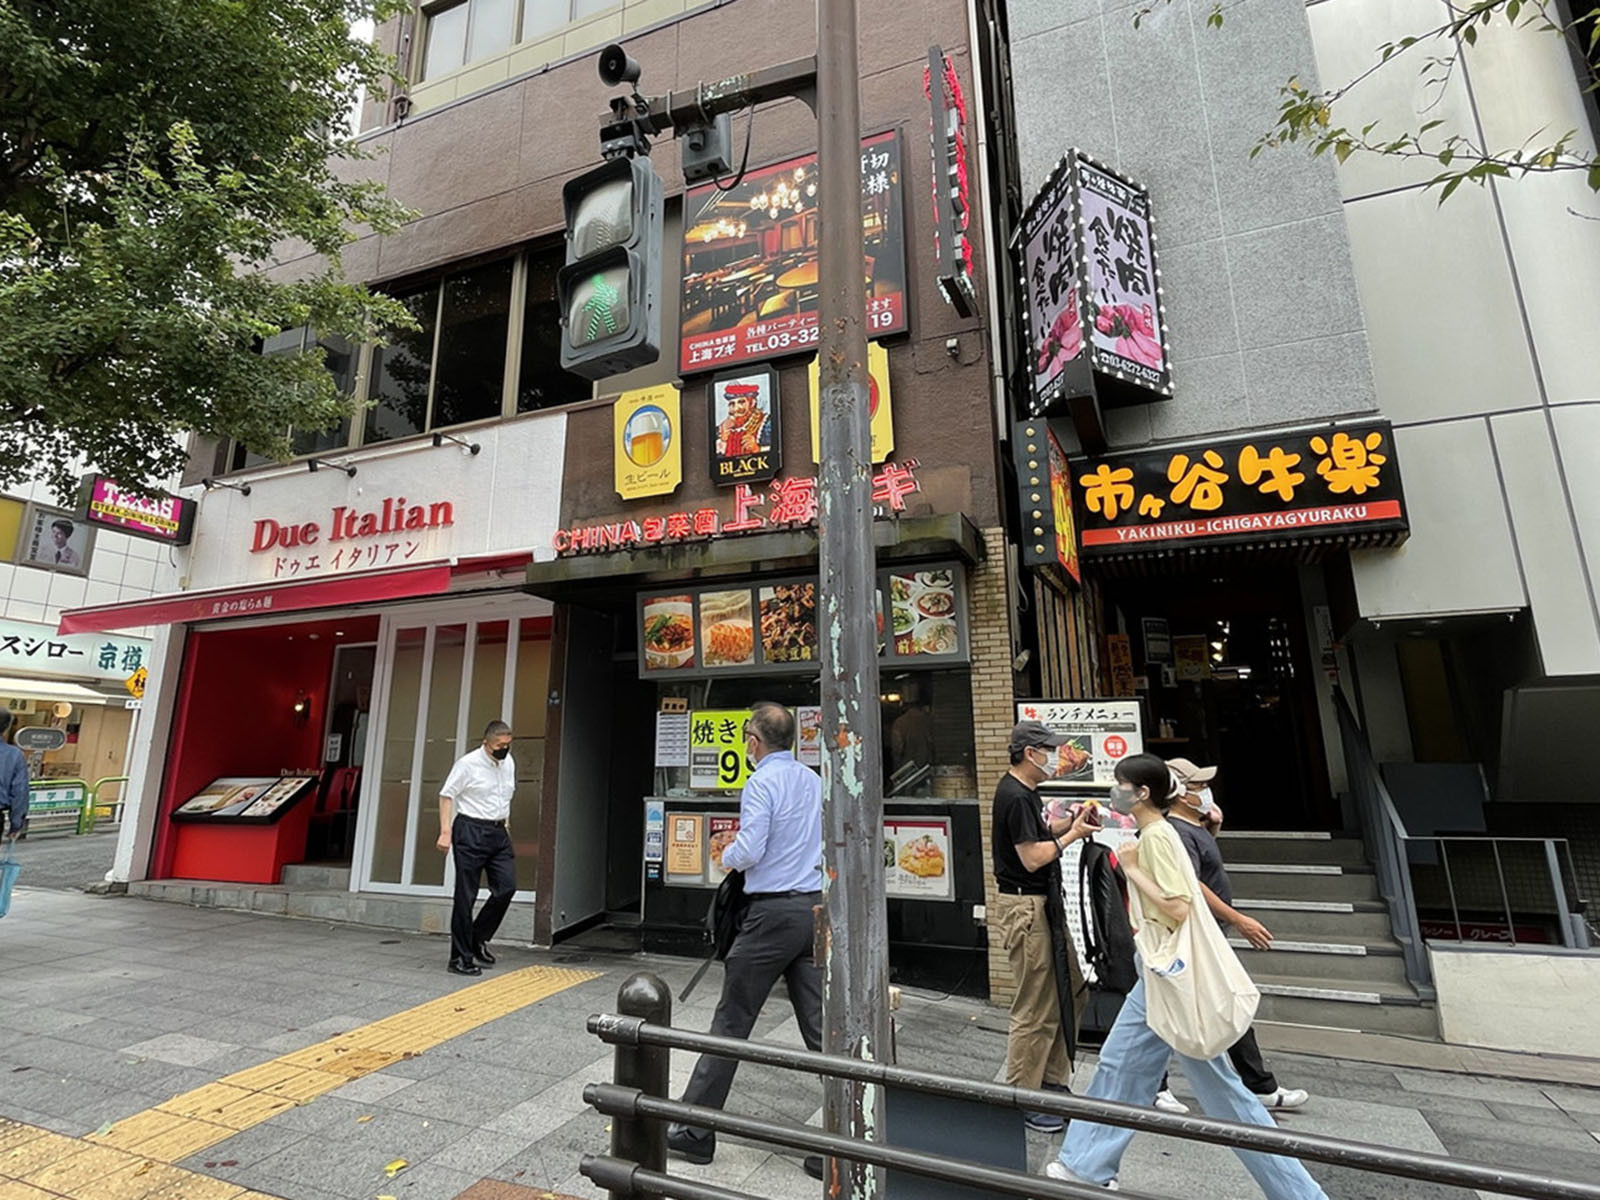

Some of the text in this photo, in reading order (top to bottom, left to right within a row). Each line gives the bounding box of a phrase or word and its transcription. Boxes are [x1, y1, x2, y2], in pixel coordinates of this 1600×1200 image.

[688, 342, 736, 363] 上海ブギ
[719, 456, 770, 476] BLACK
[250, 497, 454, 553] Due Italian
[552, 520, 641, 552] CHINA
[273, 540, 420, 578] ドゥエ イタリアン
[0, 635, 84, 657] スシロー
[1047, 708, 1134, 720] ランチメニュー
